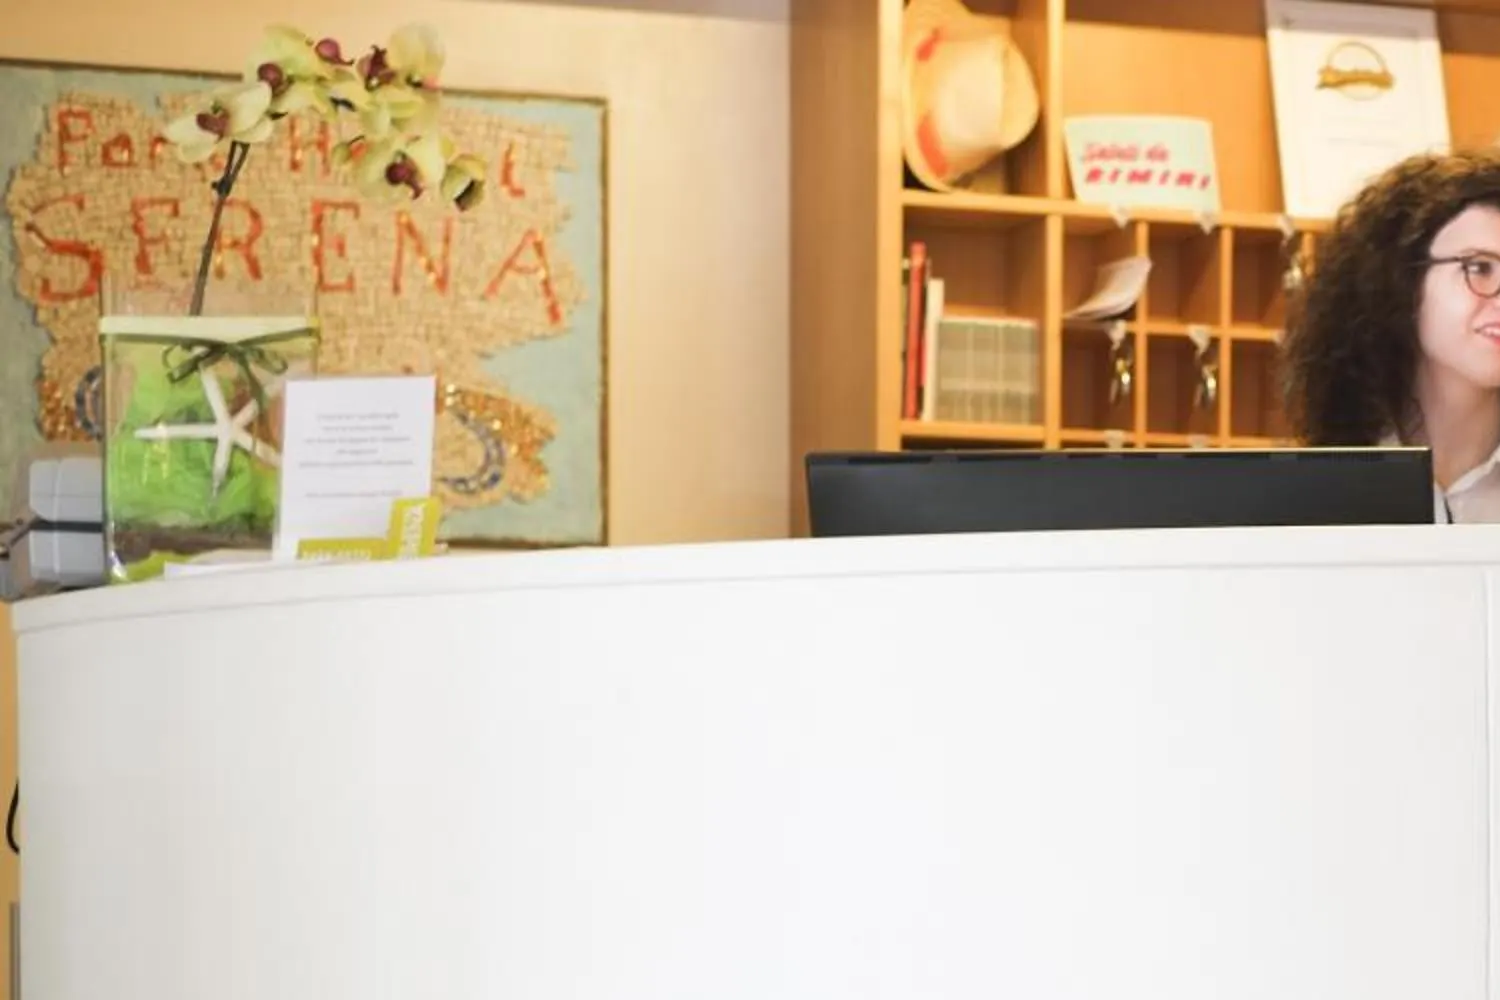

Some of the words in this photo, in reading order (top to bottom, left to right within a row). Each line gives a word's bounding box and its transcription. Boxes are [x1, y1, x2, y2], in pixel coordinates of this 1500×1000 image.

[57, 108, 226, 176] Par
[1086, 166, 1211, 190] RIMINI
[25, 196, 563, 326] SERENA
